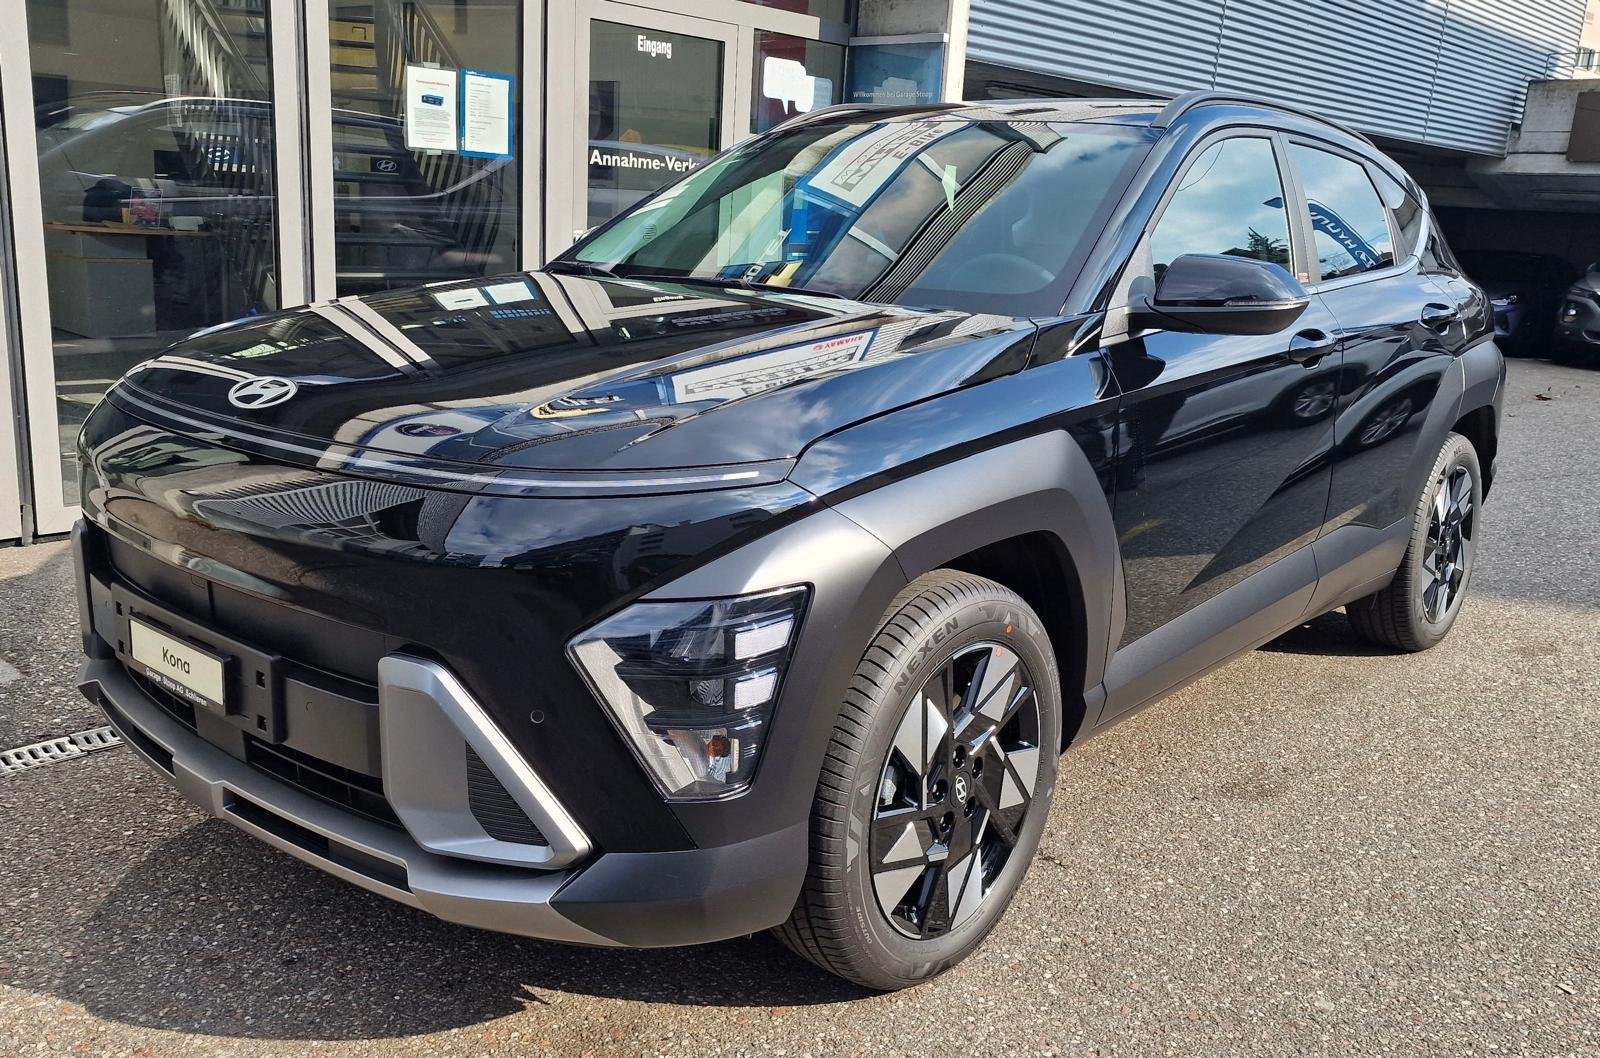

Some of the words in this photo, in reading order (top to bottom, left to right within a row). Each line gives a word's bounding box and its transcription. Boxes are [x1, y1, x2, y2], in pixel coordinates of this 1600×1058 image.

[637, 35, 672, 59] Eingang
[589, 149, 700, 172] Annahme-Verk
[162, 646, 191, 675] Kona
[894, 616, 960, 697] NEXEN
